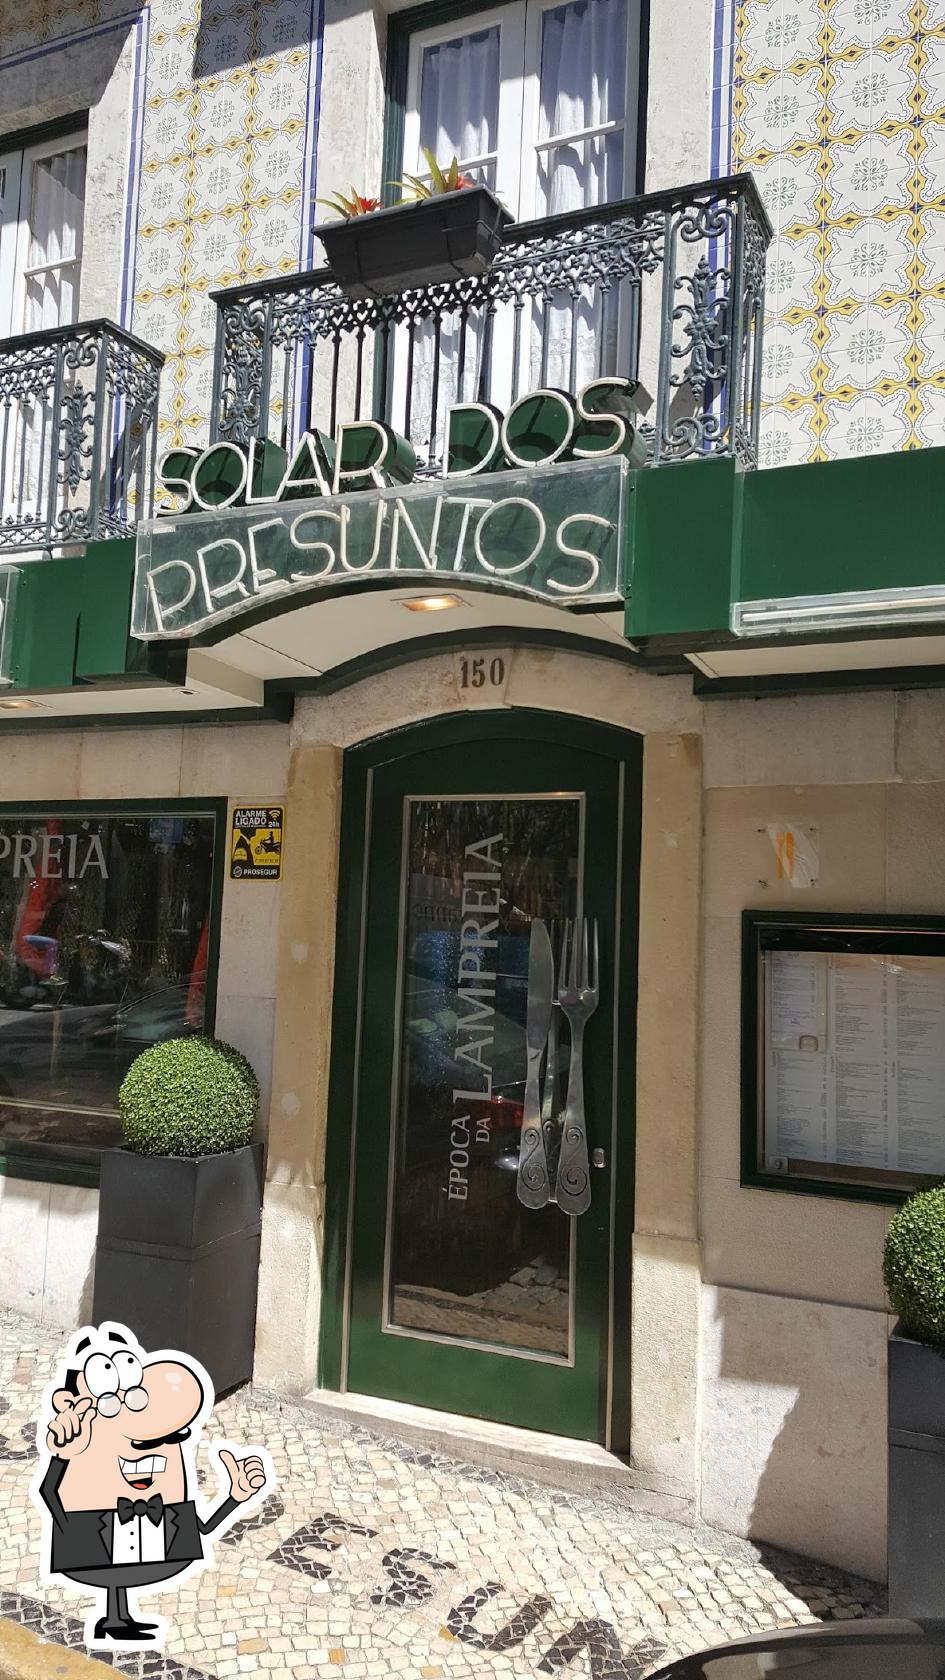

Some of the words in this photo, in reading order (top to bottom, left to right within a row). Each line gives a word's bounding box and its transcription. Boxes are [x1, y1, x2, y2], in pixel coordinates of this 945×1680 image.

[154, 419, 388, 515] SOLAR
[442, 376, 634, 479] DOS
[146, 496, 614, 632] PRESUNTOS
[459, 656, 505, 689] 150
[235, 810, 267, 818] ALARME
[235, 817, 267, 826] LIGADO
[243, 868, 278, 876] PROSEGUR
[453, 832, 503, 1104] LAMPREIA
[475, 1117, 491, 1143] DA
[441, 1114, 471, 1200] ÉPOCA
